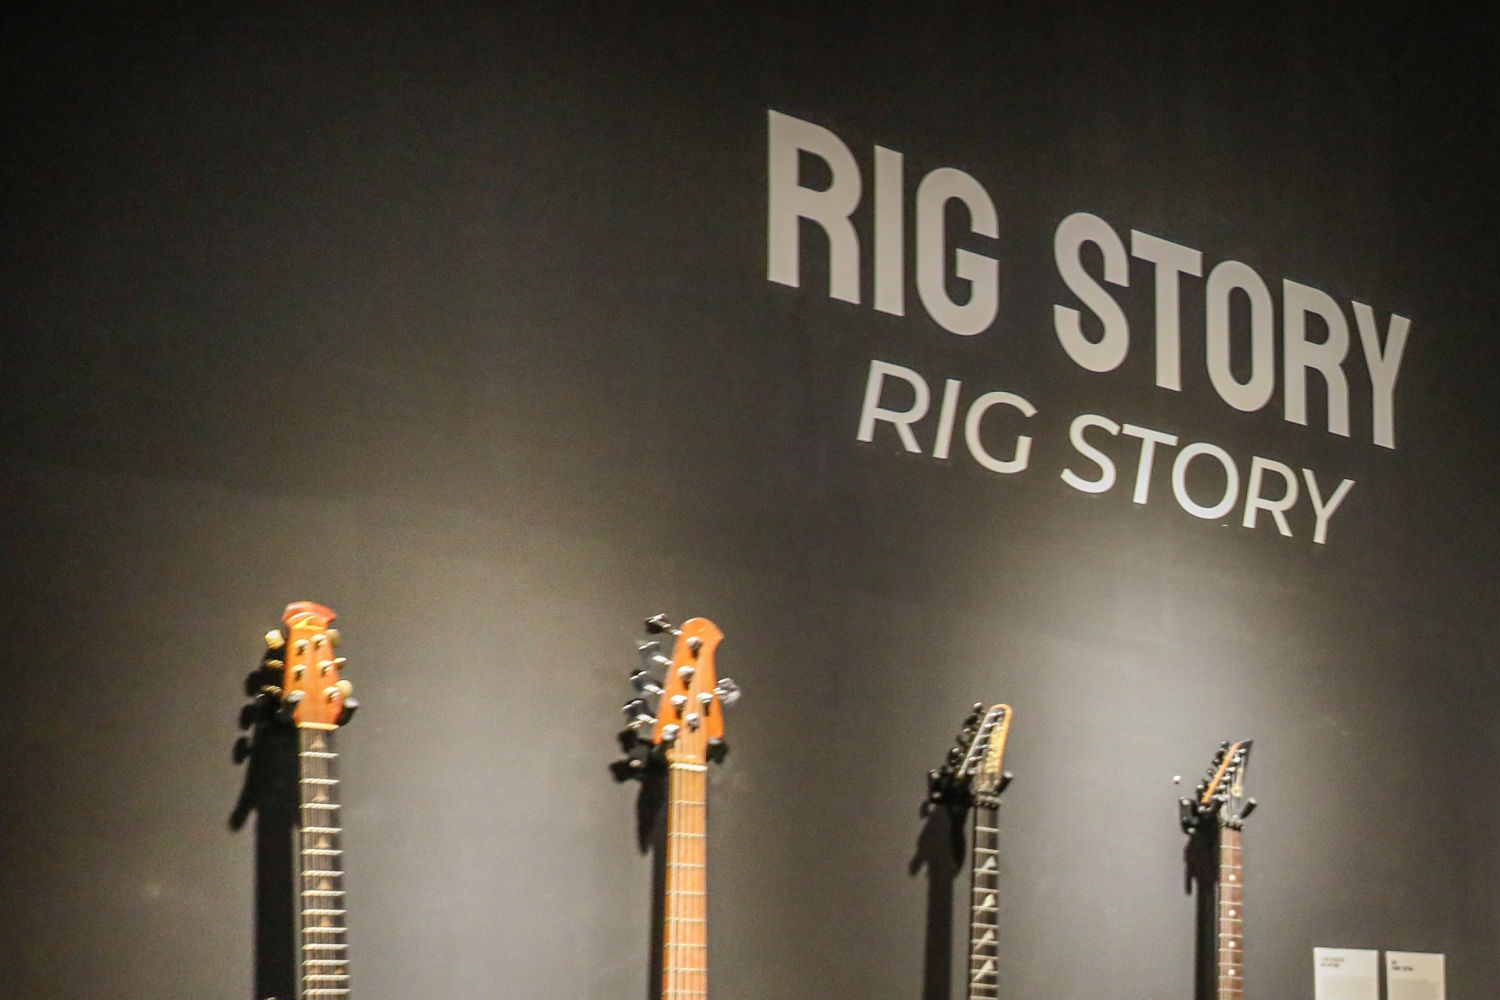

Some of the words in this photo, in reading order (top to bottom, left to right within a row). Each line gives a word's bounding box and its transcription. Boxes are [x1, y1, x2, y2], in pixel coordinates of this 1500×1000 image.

[766, 109, 1000, 337] RIG
[1053, 211, 1412, 450] STORY
[855, 358, 1038, 476] RIG
[1059, 413, 1356, 546] STORY
